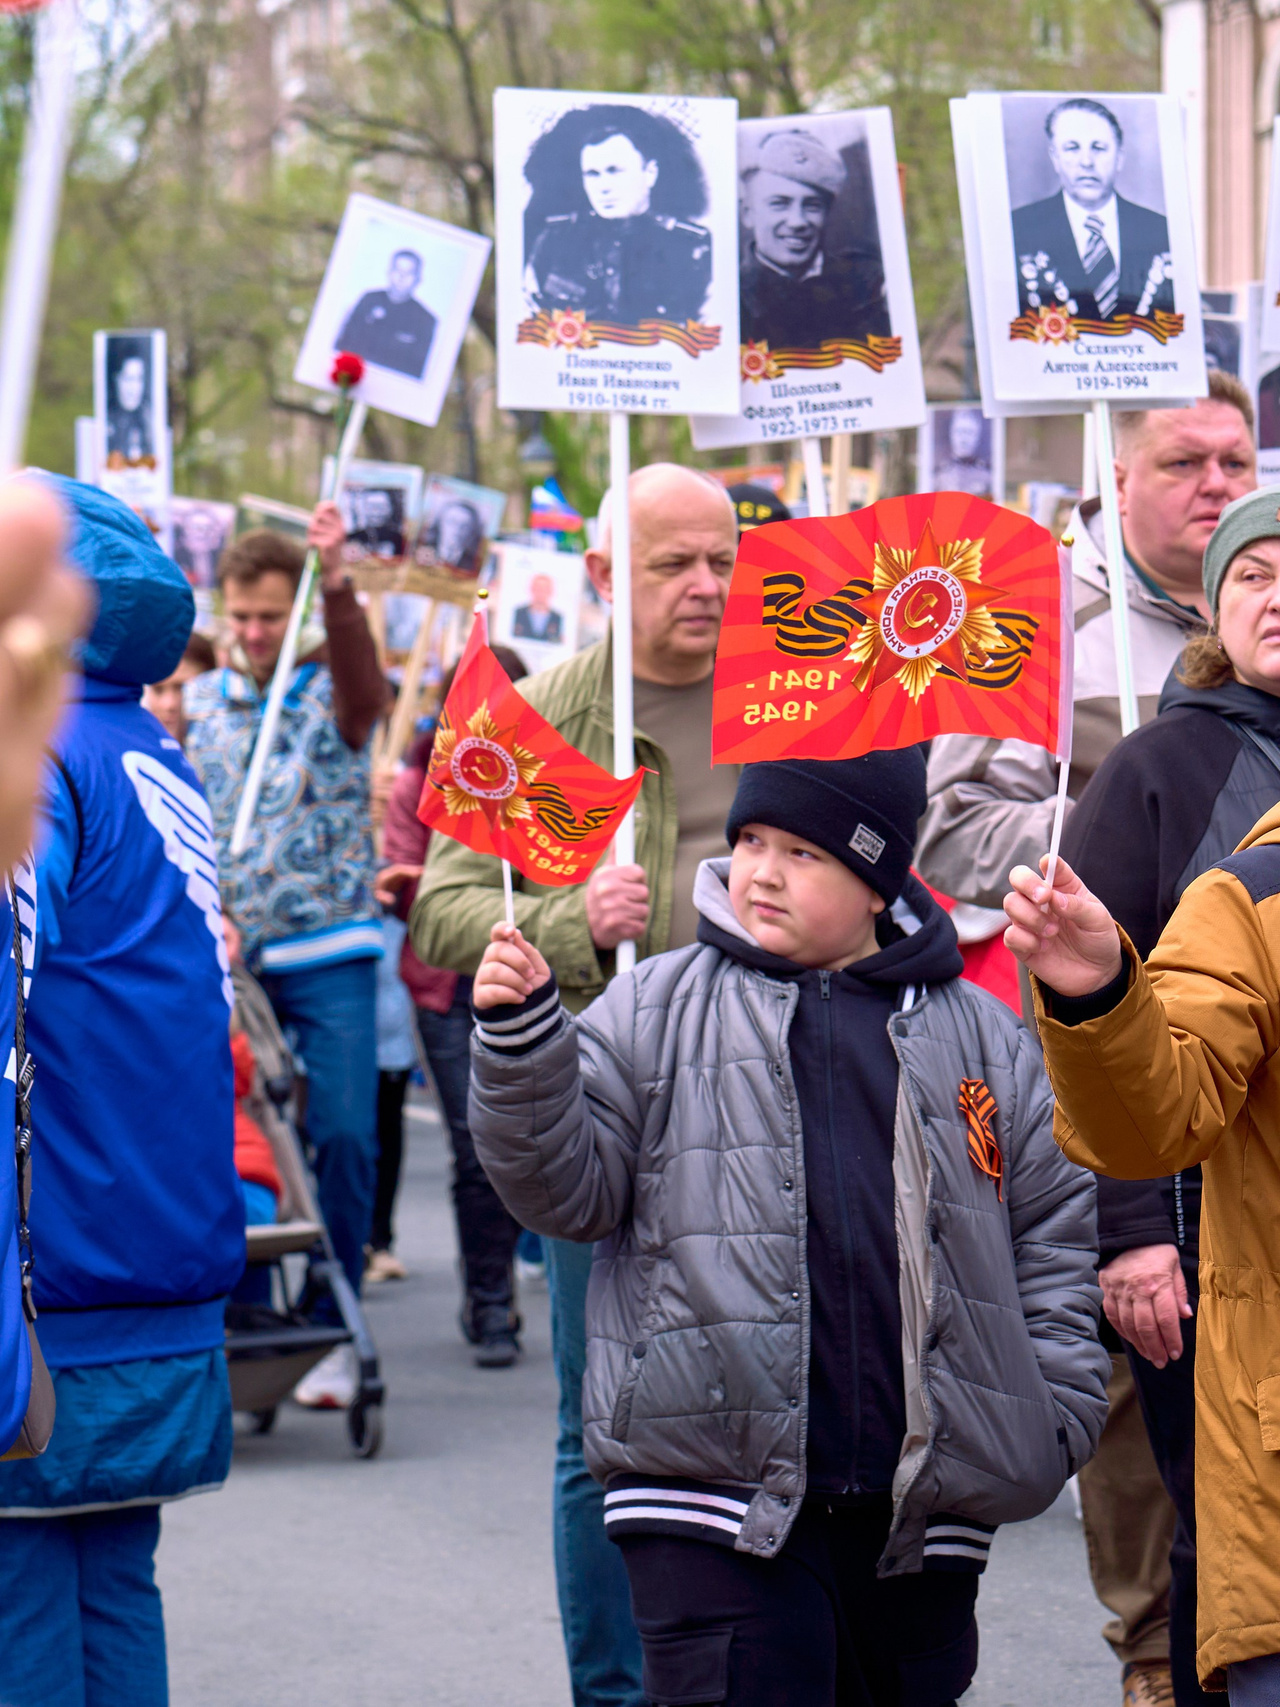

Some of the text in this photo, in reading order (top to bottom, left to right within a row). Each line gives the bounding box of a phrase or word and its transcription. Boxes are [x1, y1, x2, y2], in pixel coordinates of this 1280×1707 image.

[566, 354, 672, 374] Пономаренко
[1043, 361, 1179, 374] Антон Алексеевич
[558, 372, 681, 391] Иван Иванович
[770, 380, 842, 399] Шолохов
[1075, 376, 1149, 390] 1919-1994
[568, 392, 648, 408] 1910-1984
[797, 397, 874, 415] Иванович
[761, 417, 839, 438] 1922-1973
[528, 848, 579, 876] 1945
